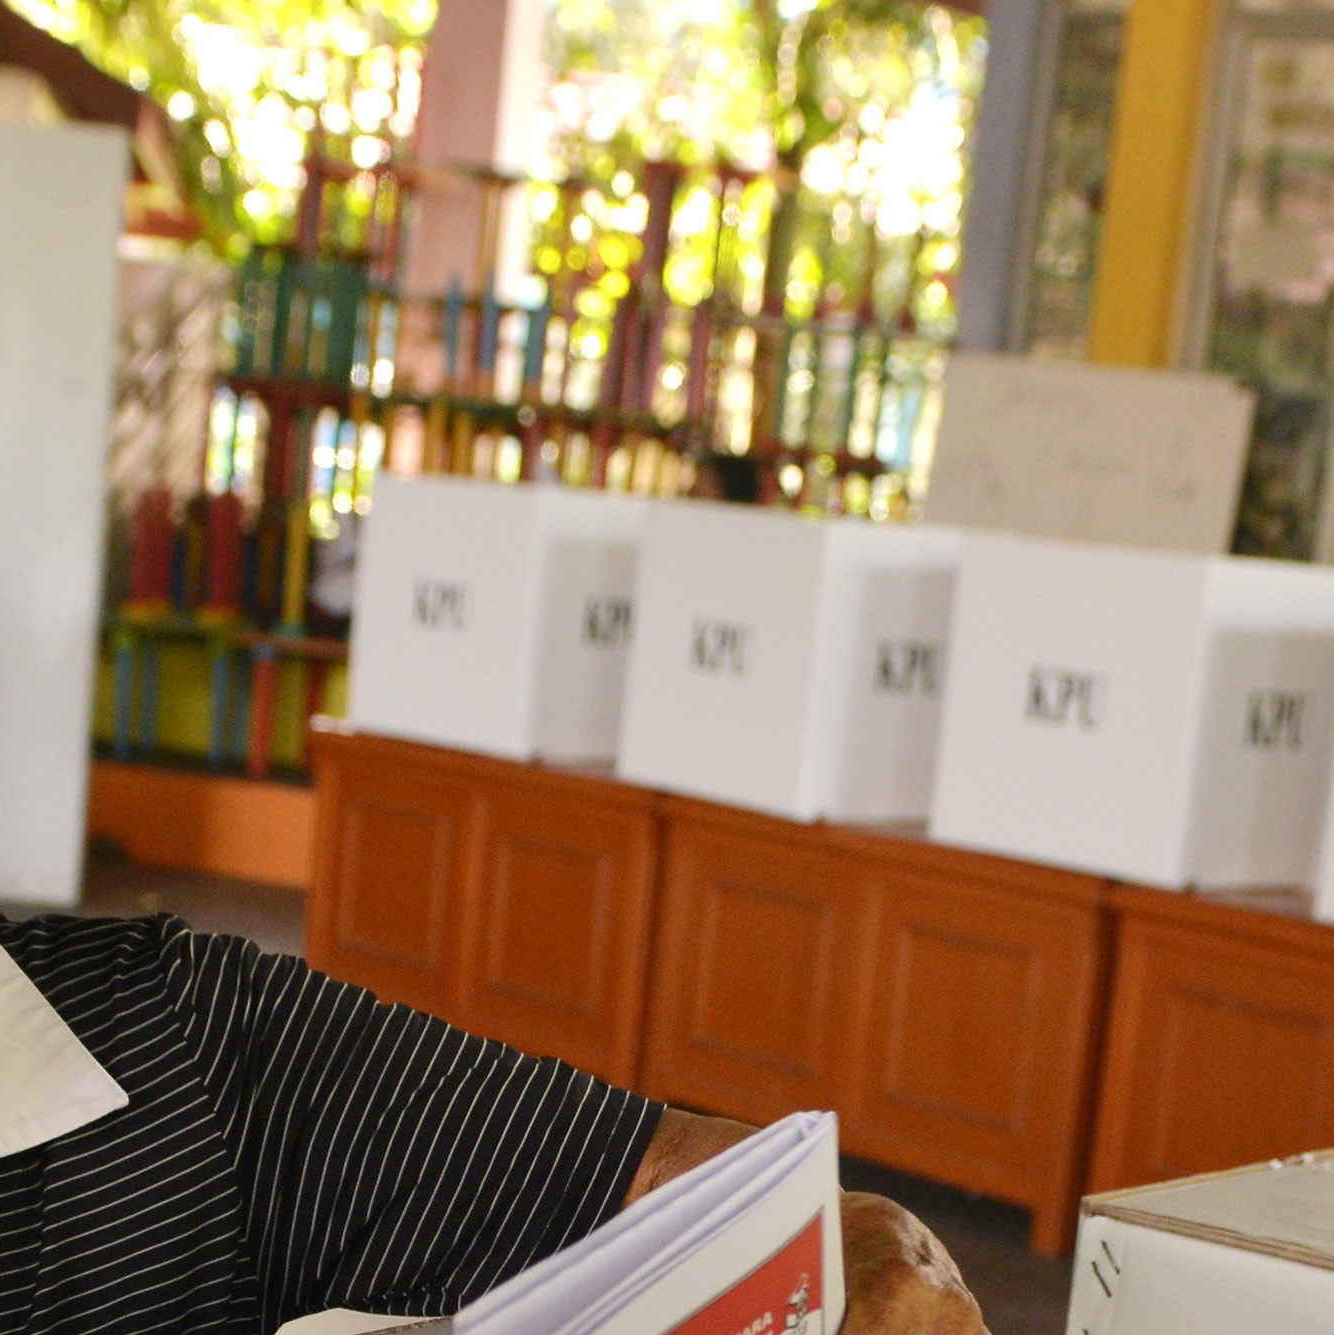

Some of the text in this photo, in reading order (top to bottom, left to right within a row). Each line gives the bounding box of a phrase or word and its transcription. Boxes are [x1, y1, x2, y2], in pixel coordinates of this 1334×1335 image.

[412, 577, 469, 628] KPU
[691, 618, 749, 678] KPU
[1025, 665, 1108, 730] KPU
[1242, 691, 1307, 750] KPU
